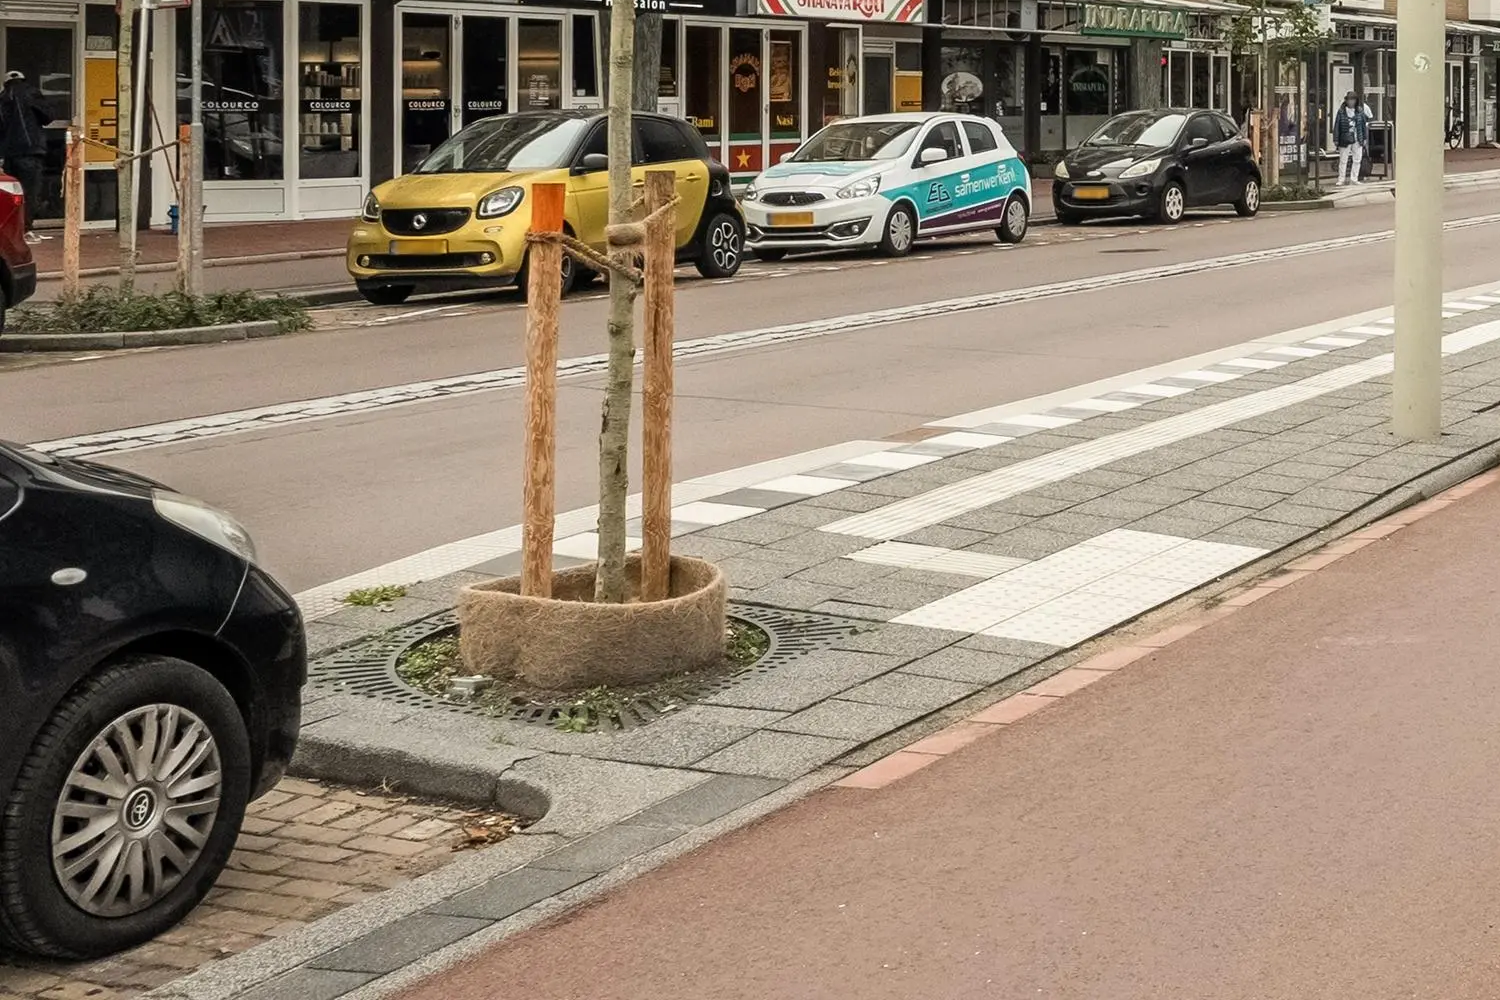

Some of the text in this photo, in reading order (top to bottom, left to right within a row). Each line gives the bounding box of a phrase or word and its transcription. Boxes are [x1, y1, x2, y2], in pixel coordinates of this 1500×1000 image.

[1084, 3, 1188, 34] INDRAPURA
[310, 101, 350, 109] COLOURCO
[776, 114, 794, 126] Nasi
